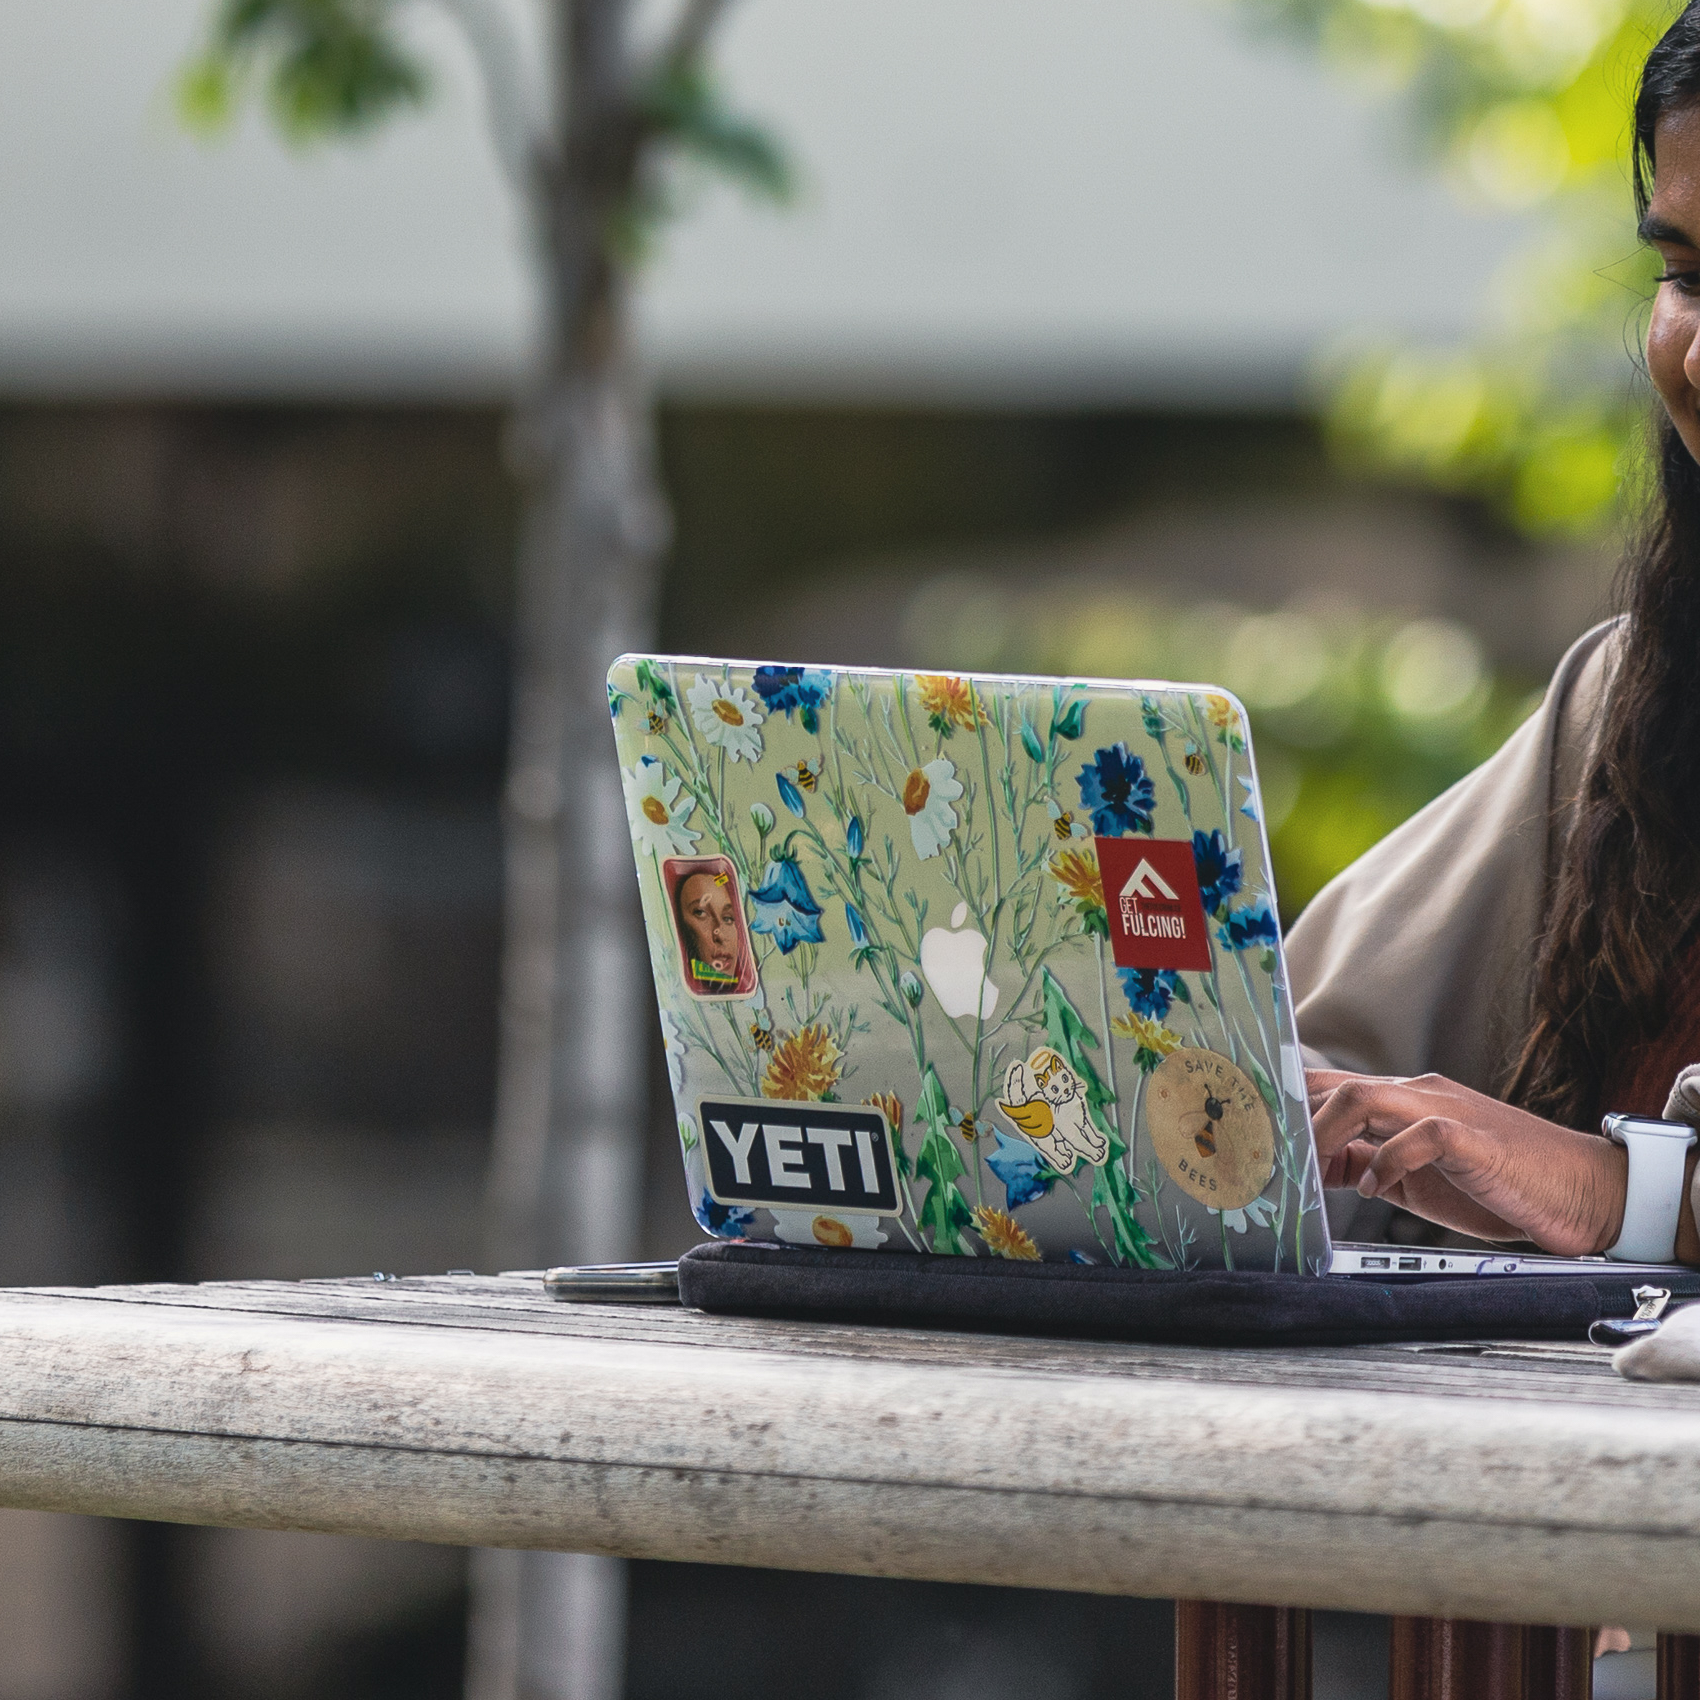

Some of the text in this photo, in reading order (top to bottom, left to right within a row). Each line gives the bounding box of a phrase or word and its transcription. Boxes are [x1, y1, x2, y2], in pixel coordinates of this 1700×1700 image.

[1119, 897, 1138, 914] GET
[1121, 912, 1186, 939] FULCING!
[1184, 1060, 1256, 1112] SAVE THE
[1178, 1159, 1218, 1191] BEES
